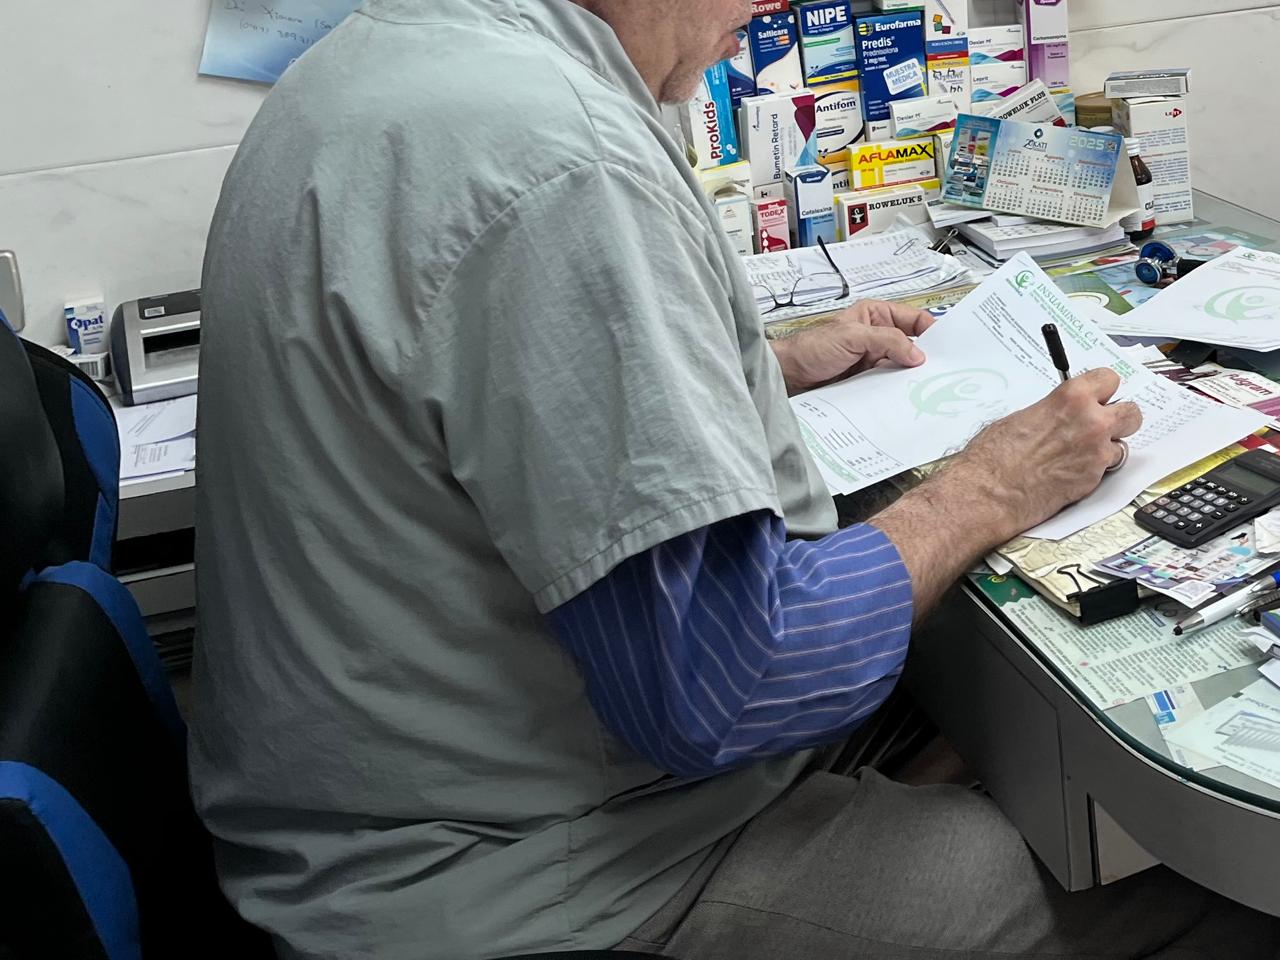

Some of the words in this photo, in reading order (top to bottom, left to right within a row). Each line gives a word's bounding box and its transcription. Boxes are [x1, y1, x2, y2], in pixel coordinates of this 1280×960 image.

[752, 1, 782, 13] Rowe
[806, 6, 847, 27] NIPE
[875, 19, 921, 32] Eurofarma
[862, 38, 892, 50] Predis
[886, 62, 917, 79] MUESTRA
[1030, 90, 1046, 105] PLUS
[816, 99, 856, 113] Antifom
[704, 101, 722, 161] ProKids
[1069, 136, 1104, 150] 2025
[773, 144, 781, 179] Bumetin
[859, 144, 933, 165] AFLAMAX
[760, 208, 785, 219] TODEX
